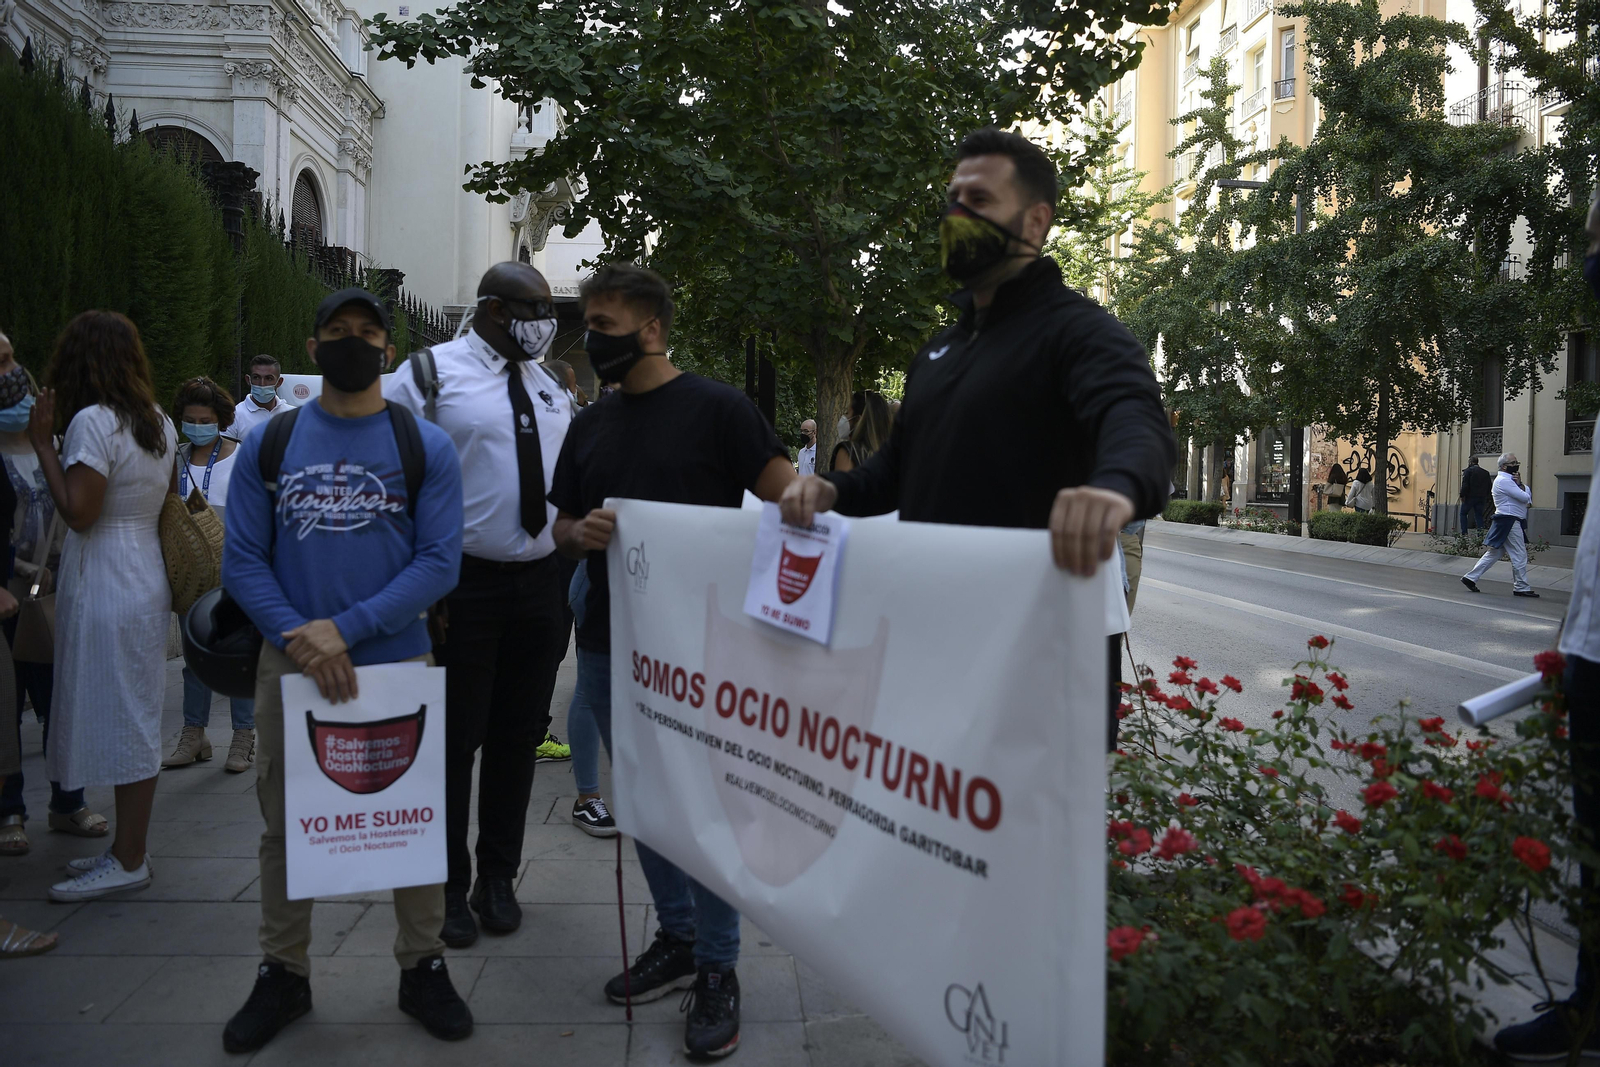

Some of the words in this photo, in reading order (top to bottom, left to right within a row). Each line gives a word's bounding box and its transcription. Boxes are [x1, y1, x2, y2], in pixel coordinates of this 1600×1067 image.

[316, 485, 353, 497] UNITED
[276, 470, 404, 541] Kingdom
[632, 650, 706, 709] SOMOS
[715, 680, 790, 739] OCIO
[798, 706, 1003, 832] NOCTURNO
[324, 756, 410, 773] OcioNocturno
[653, 711, 694, 739] PERSONAS
[695, 728, 722, 750] VIVEN
[724, 740, 744, 759] DEL
[747, 749, 773, 770] OCIO
[899, 825, 989, 879] GARITOBAR
[299, 816, 328, 834] YO
[335, 813, 366, 831] ME
[372, 807, 434, 827] SUMO
[309, 833, 356, 846] Salvemos
[358, 831, 368, 840] la
[328, 845, 338, 855] el
[339, 843, 362, 854] Ocio
[364, 839, 408, 852] Nocturno
